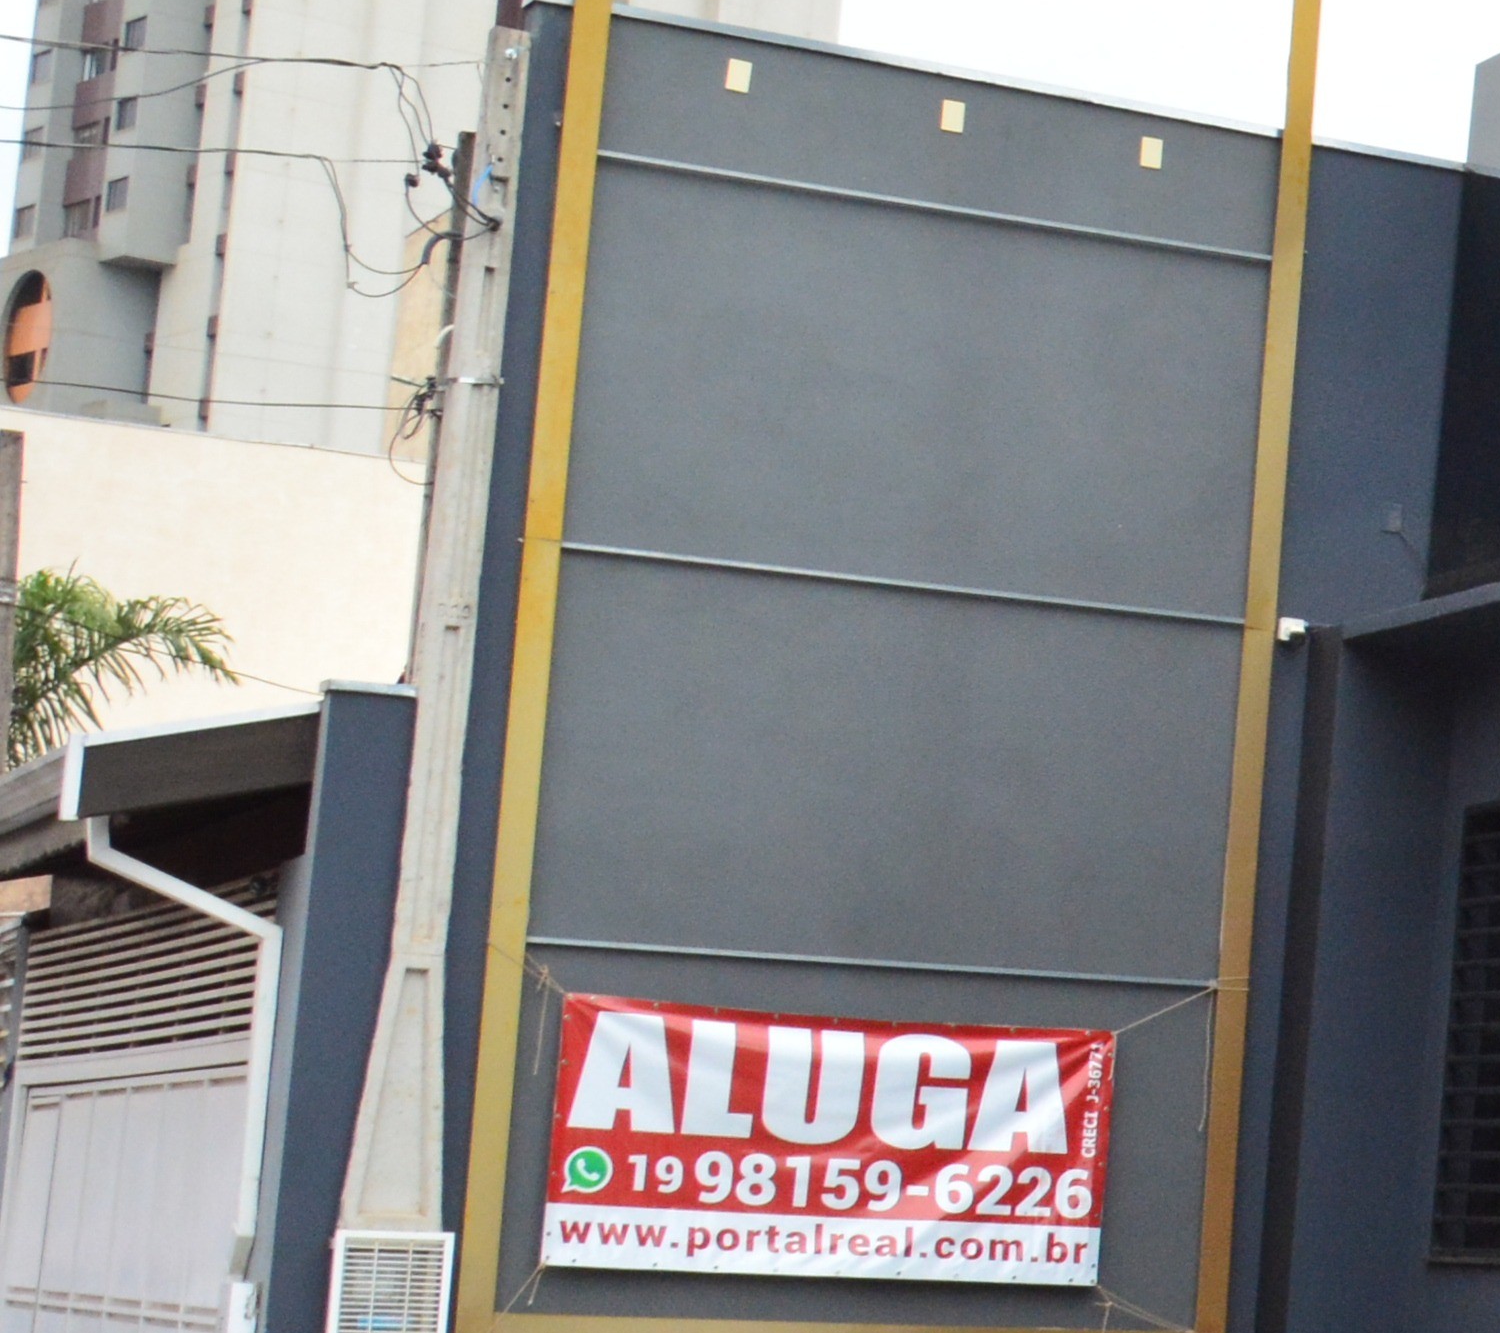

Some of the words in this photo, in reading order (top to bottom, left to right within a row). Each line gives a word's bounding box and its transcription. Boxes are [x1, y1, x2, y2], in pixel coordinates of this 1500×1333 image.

[567, 1010, 1067, 1156] ALUGA
[1086, 1042, 1104, 1104] J-36771
[1081, 1111, 1099, 1158] CRECI
[629, 1153, 683, 1196] 19
[695, 1151, 1094, 1220] 98159-6226
[559, 1218, 1089, 1266] www.portalreal.com.br
